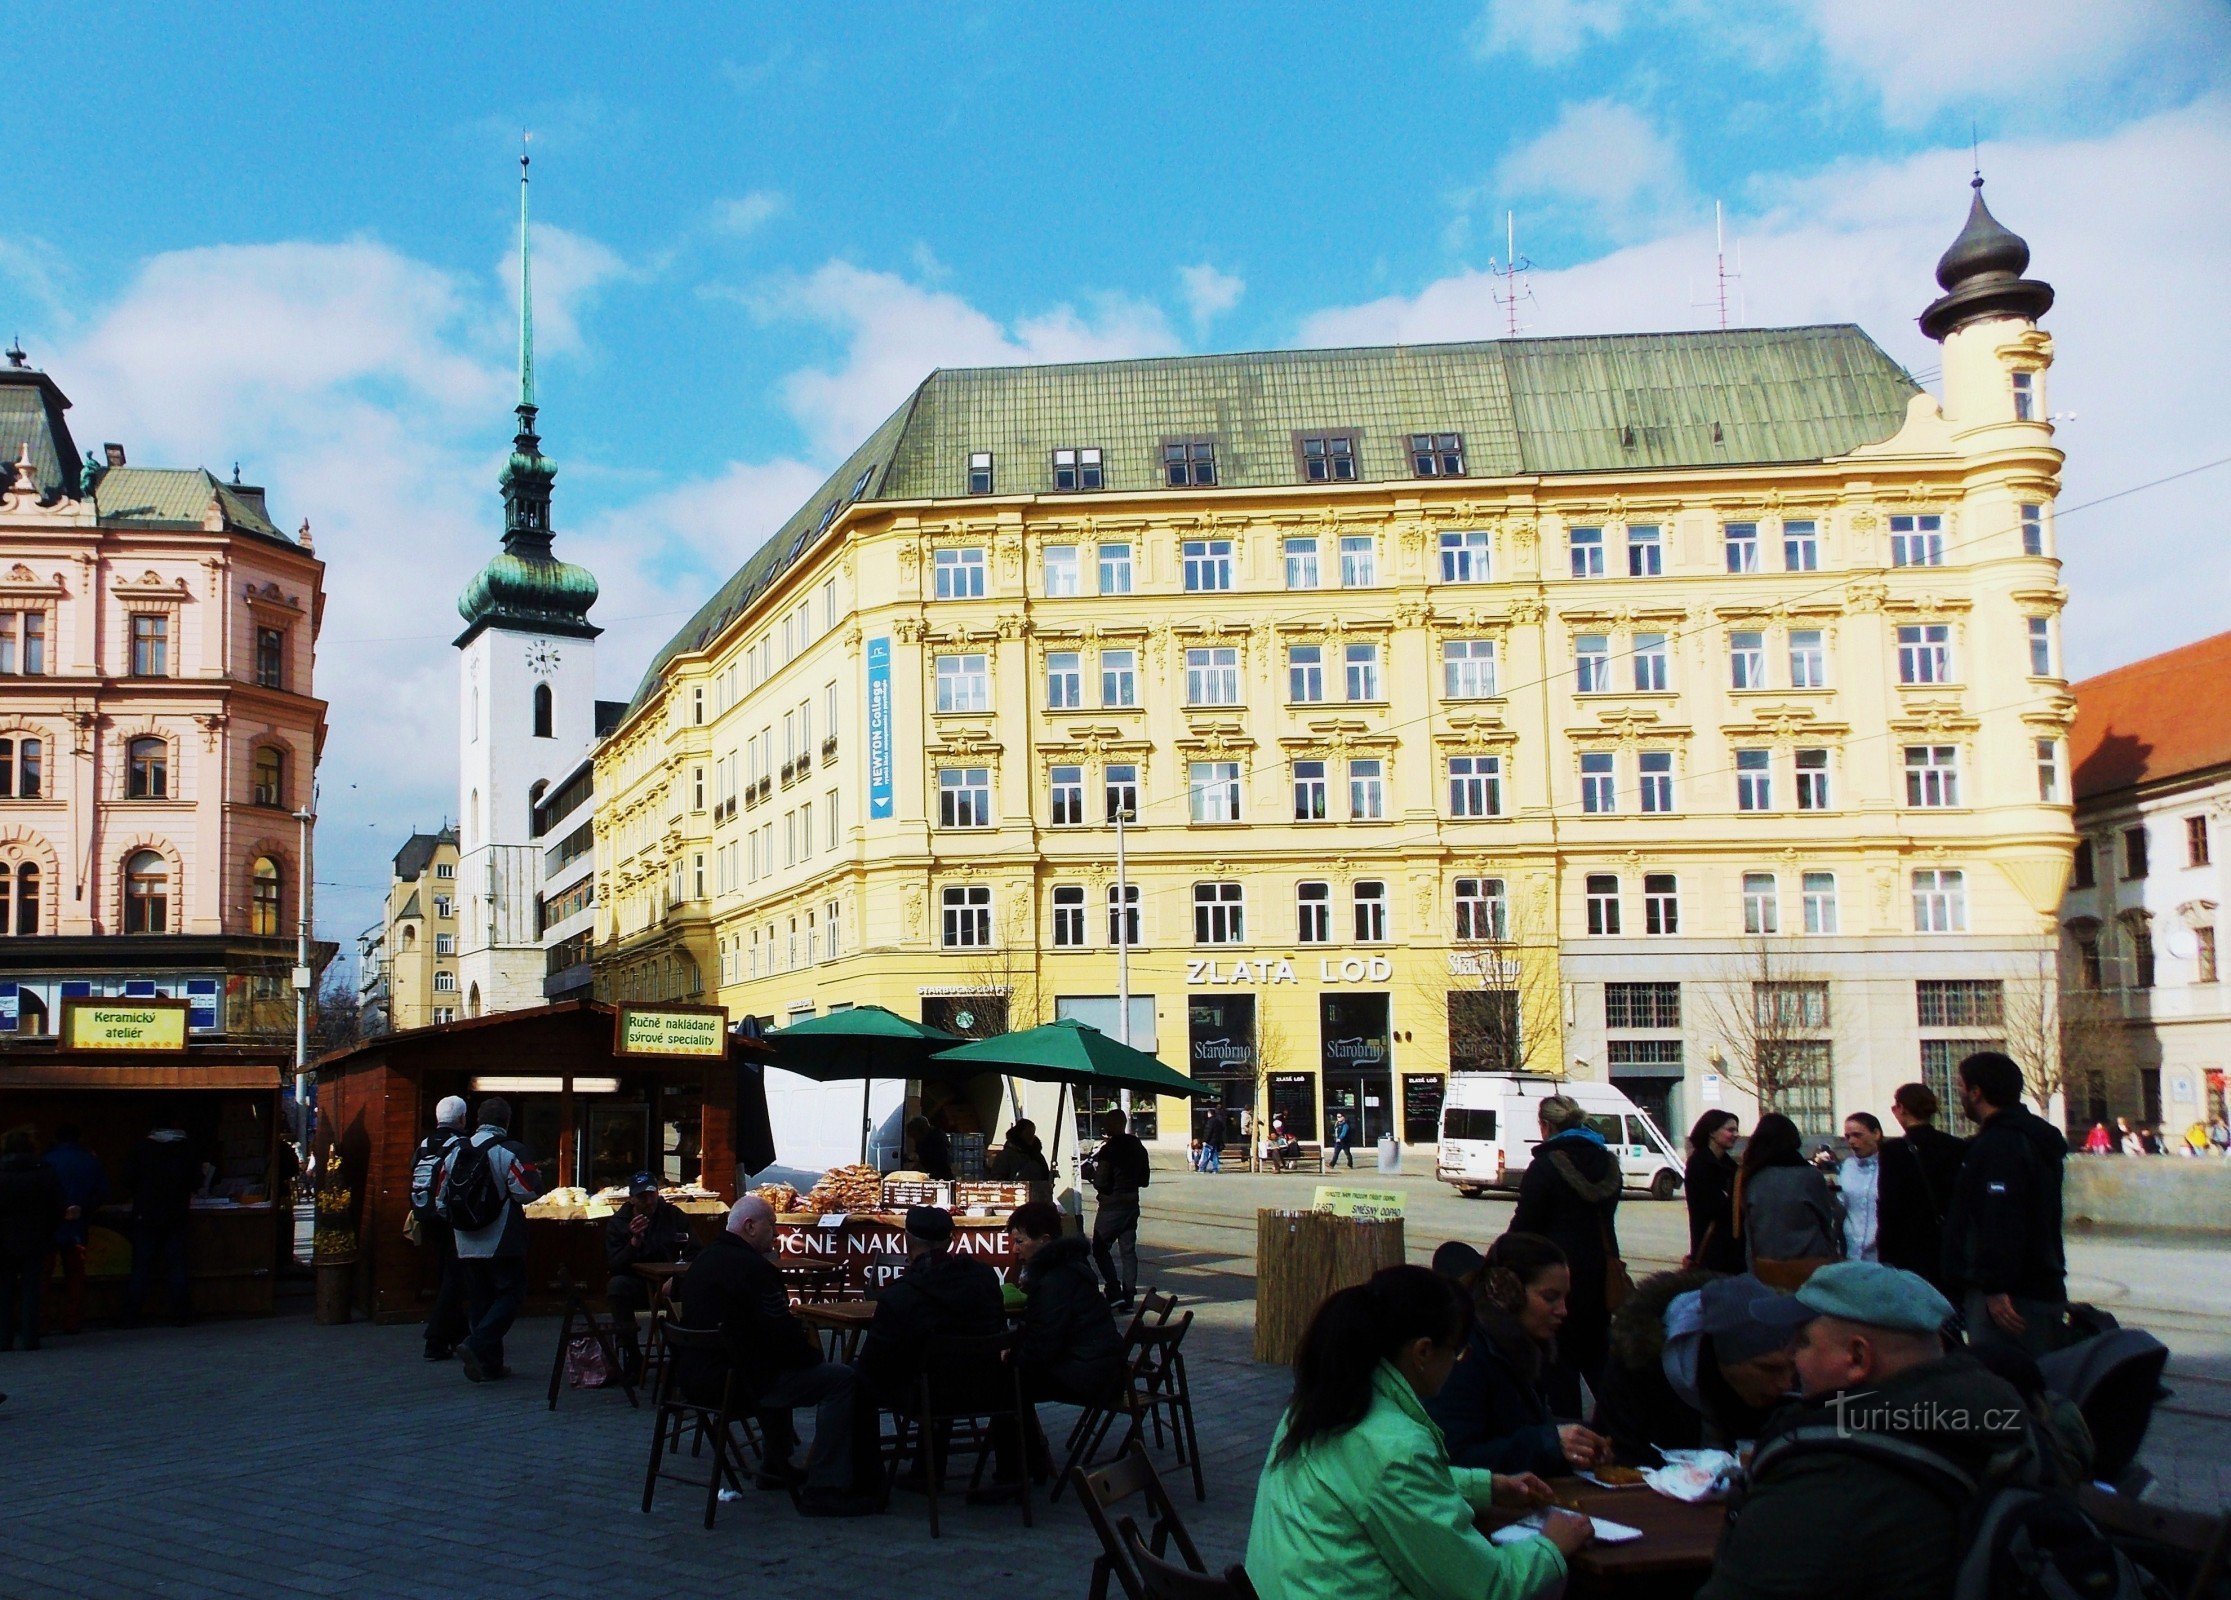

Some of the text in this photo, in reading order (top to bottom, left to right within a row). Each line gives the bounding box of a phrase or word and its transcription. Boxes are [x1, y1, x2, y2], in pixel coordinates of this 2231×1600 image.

[871, 680, 883, 787] NEWTON College
[1187, 953, 1393, 985] ZLATÁ LOĎ
[94, 1011, 156, 1023] Keramický
[629, 1016, 715, 1031] Ručně nakládané
[105, 1027, 143, 1038] ateliér
[629, 1032, 714, 1046] sýrové speciality
[1195, 1038, 1251, 1067] Starobrno
[1327, 1037, 1384, 1066] Starobrno
